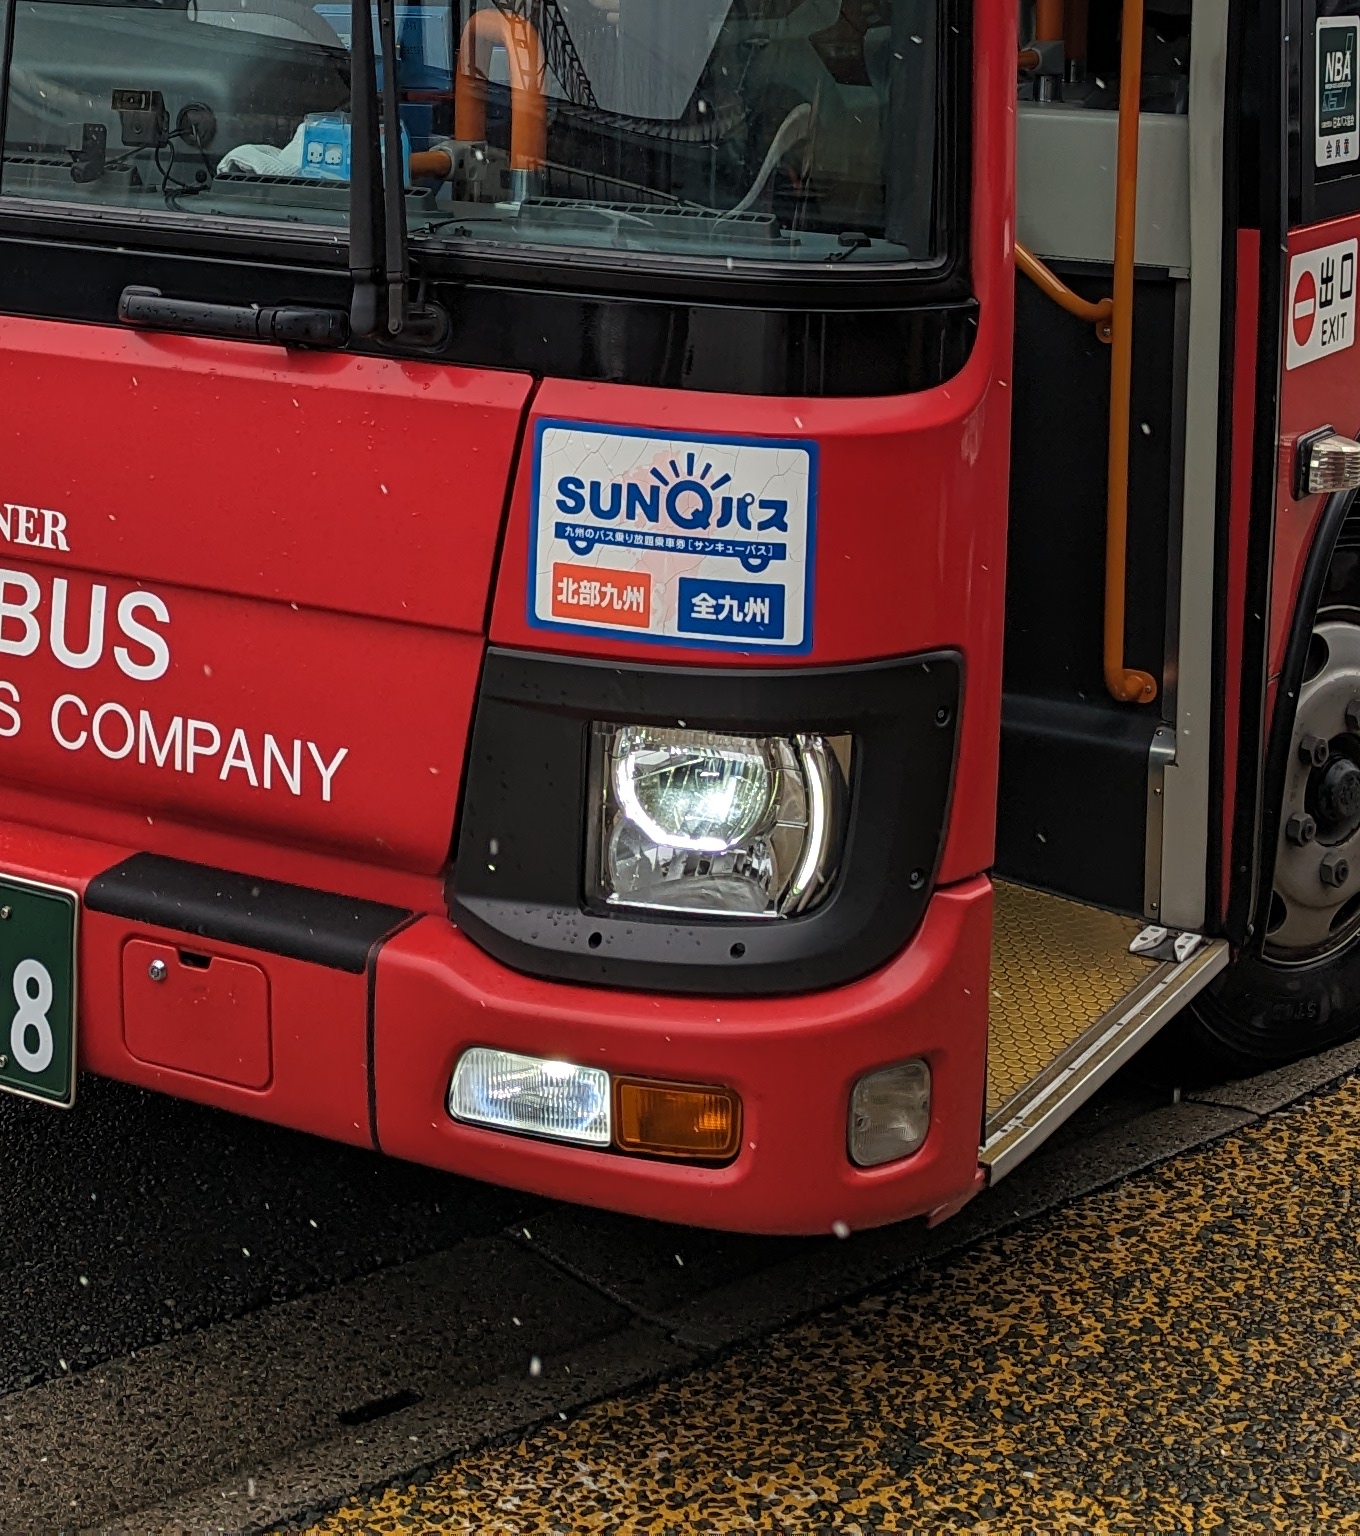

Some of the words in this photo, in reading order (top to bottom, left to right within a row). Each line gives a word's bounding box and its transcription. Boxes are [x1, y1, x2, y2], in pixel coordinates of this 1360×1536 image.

[1325, 51, 1351, 83] NBA
[1319, 252, 1353, 309] 出口
[1321, 311, 1348, 346] EXIT
[556, 475, 789, 533] SUNQパス
[557, 577, 645, 614] 北部九州
[690, 592, 770, 624] 全九州
[51, 694, 350, 802] COMPANY
